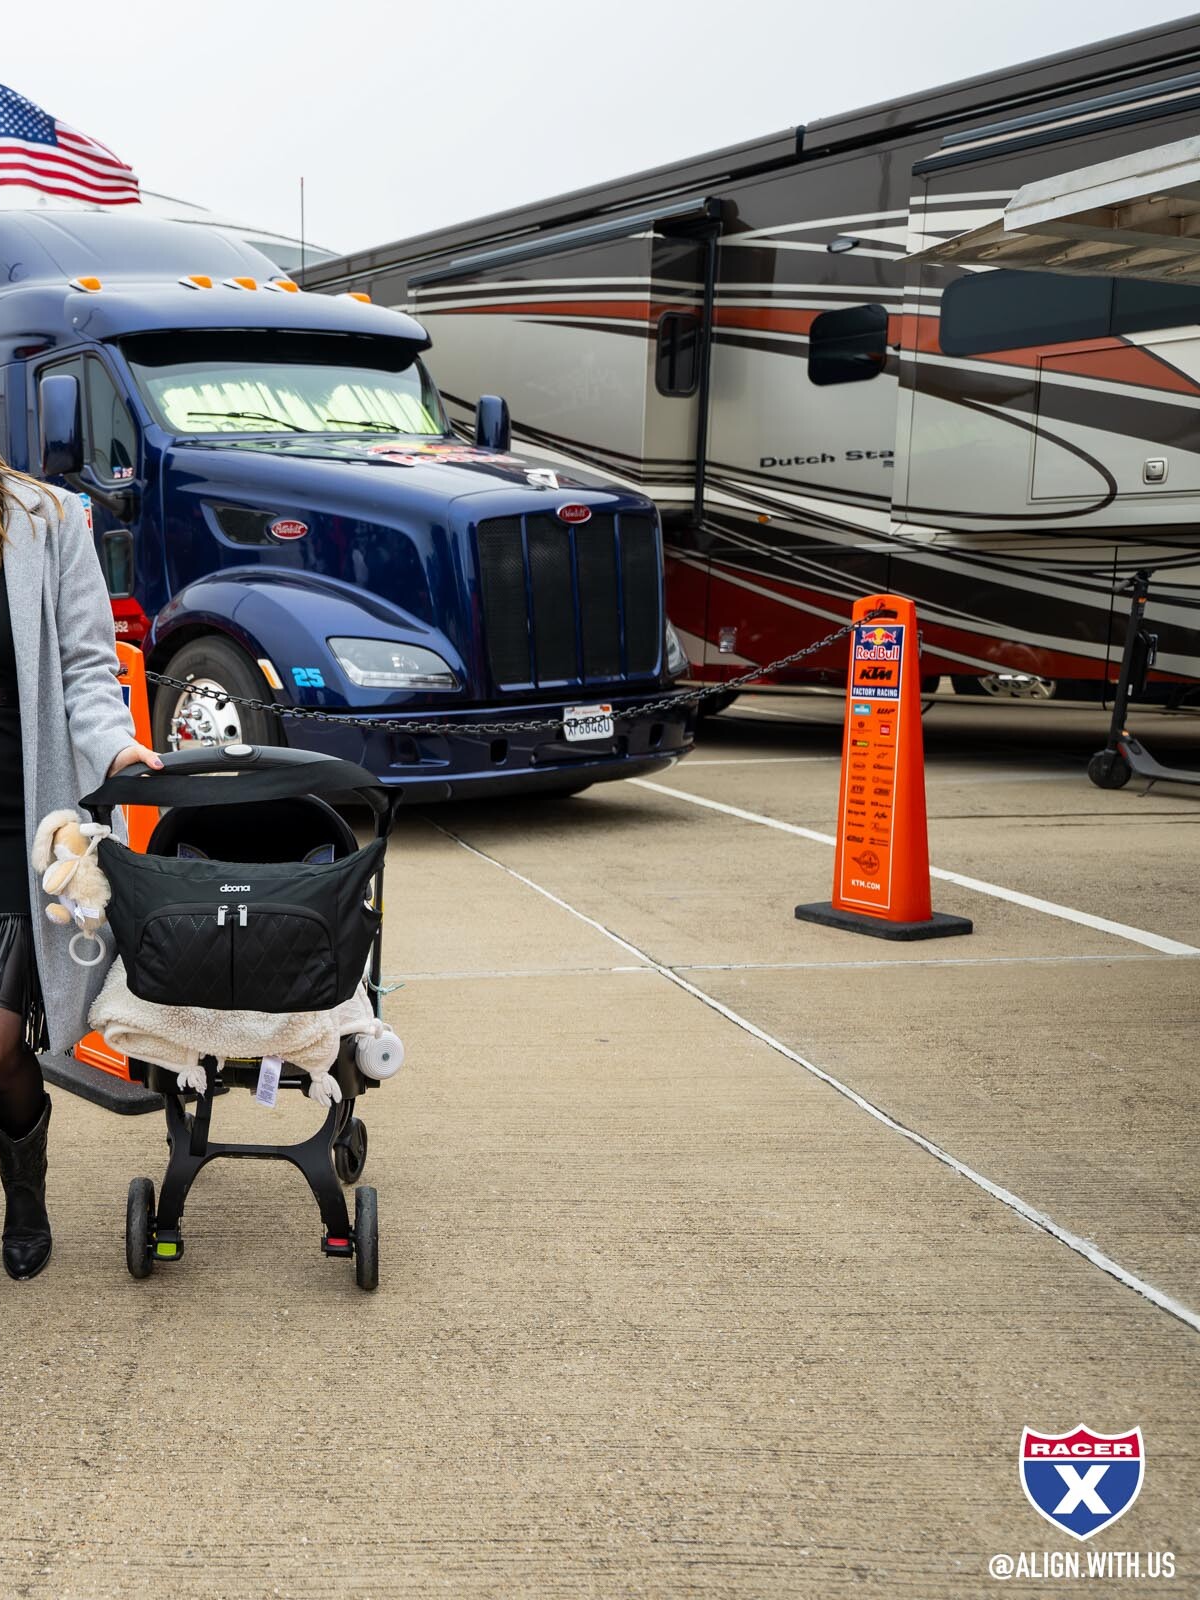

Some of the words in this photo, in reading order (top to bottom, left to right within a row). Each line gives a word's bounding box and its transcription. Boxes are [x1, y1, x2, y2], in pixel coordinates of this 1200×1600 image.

[759, 453, 835, 468] Dutch
[856, 645, 877, 660] Red
[877, 646, 900, 660] Bull
[291, 667, 325, 688] 25
[859, 666, 893, 680] KTM
[852, 687, 876, 696] FACTORY
[876, 688, 898, 697] RACING
[219, 884, 251, 892] doona
[851, 879, 881, 890] KTM.COM
